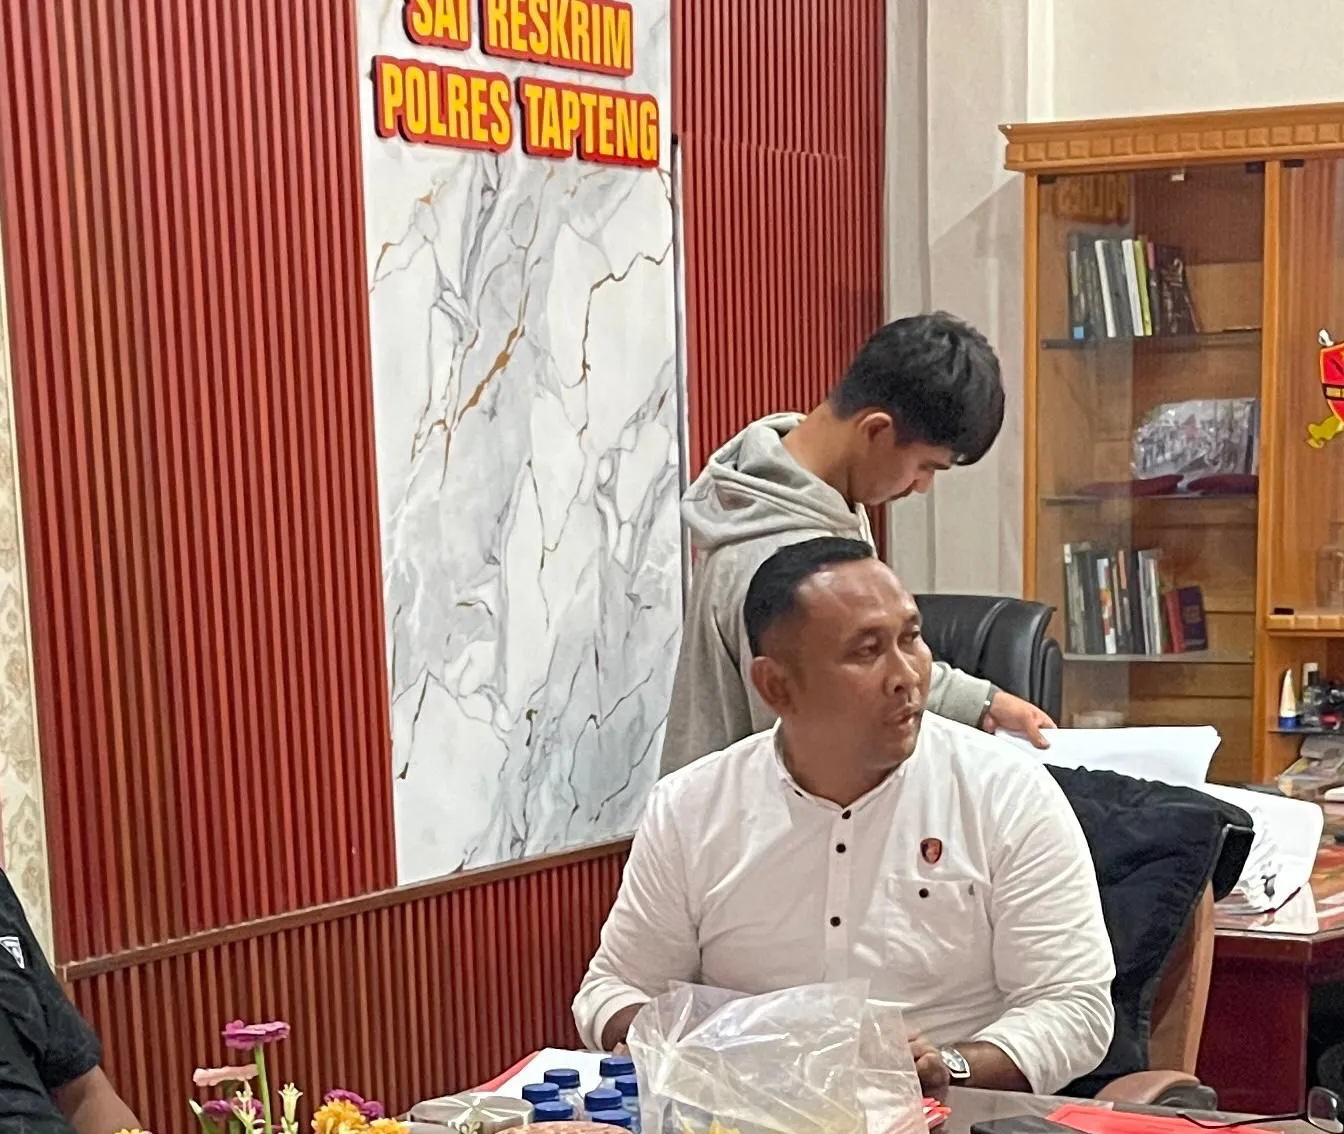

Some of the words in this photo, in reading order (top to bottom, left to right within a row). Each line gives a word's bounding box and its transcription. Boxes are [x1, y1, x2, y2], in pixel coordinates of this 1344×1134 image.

[487, 0, 632, 70] RESKRIM
[381, 62, 511, 145] POLRES
[524, 83, 658, 161] TAPTENG
